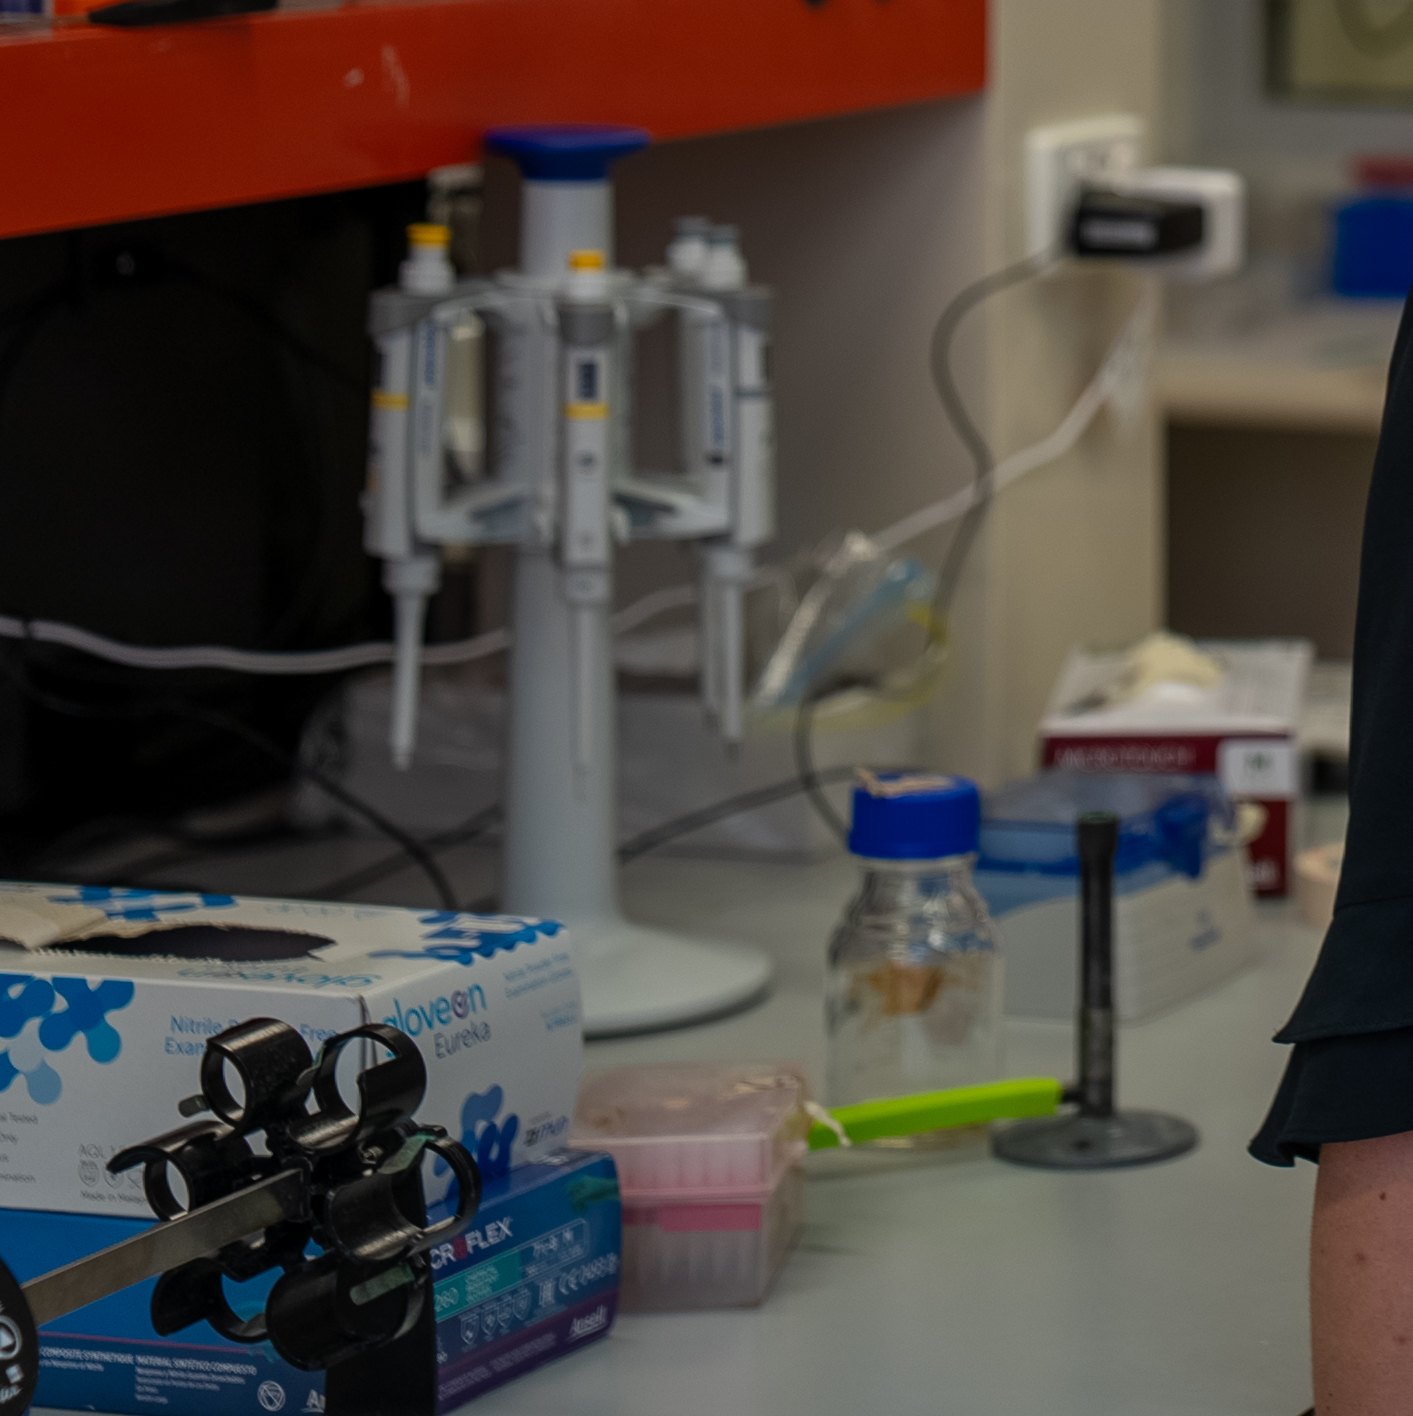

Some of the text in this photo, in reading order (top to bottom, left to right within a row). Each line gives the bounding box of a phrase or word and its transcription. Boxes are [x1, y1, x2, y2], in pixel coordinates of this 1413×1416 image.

[170, 1015, 223, 1036] Nitrile
[300, 1023, 338, 1043] Free
[433, 1020, 492, 1060] Eureka
[78, 1143, 107, 1160] AQL
[80, 1189, 147, 1206] Made in Malay
[569, 1304, 608, 1335] Ansell
